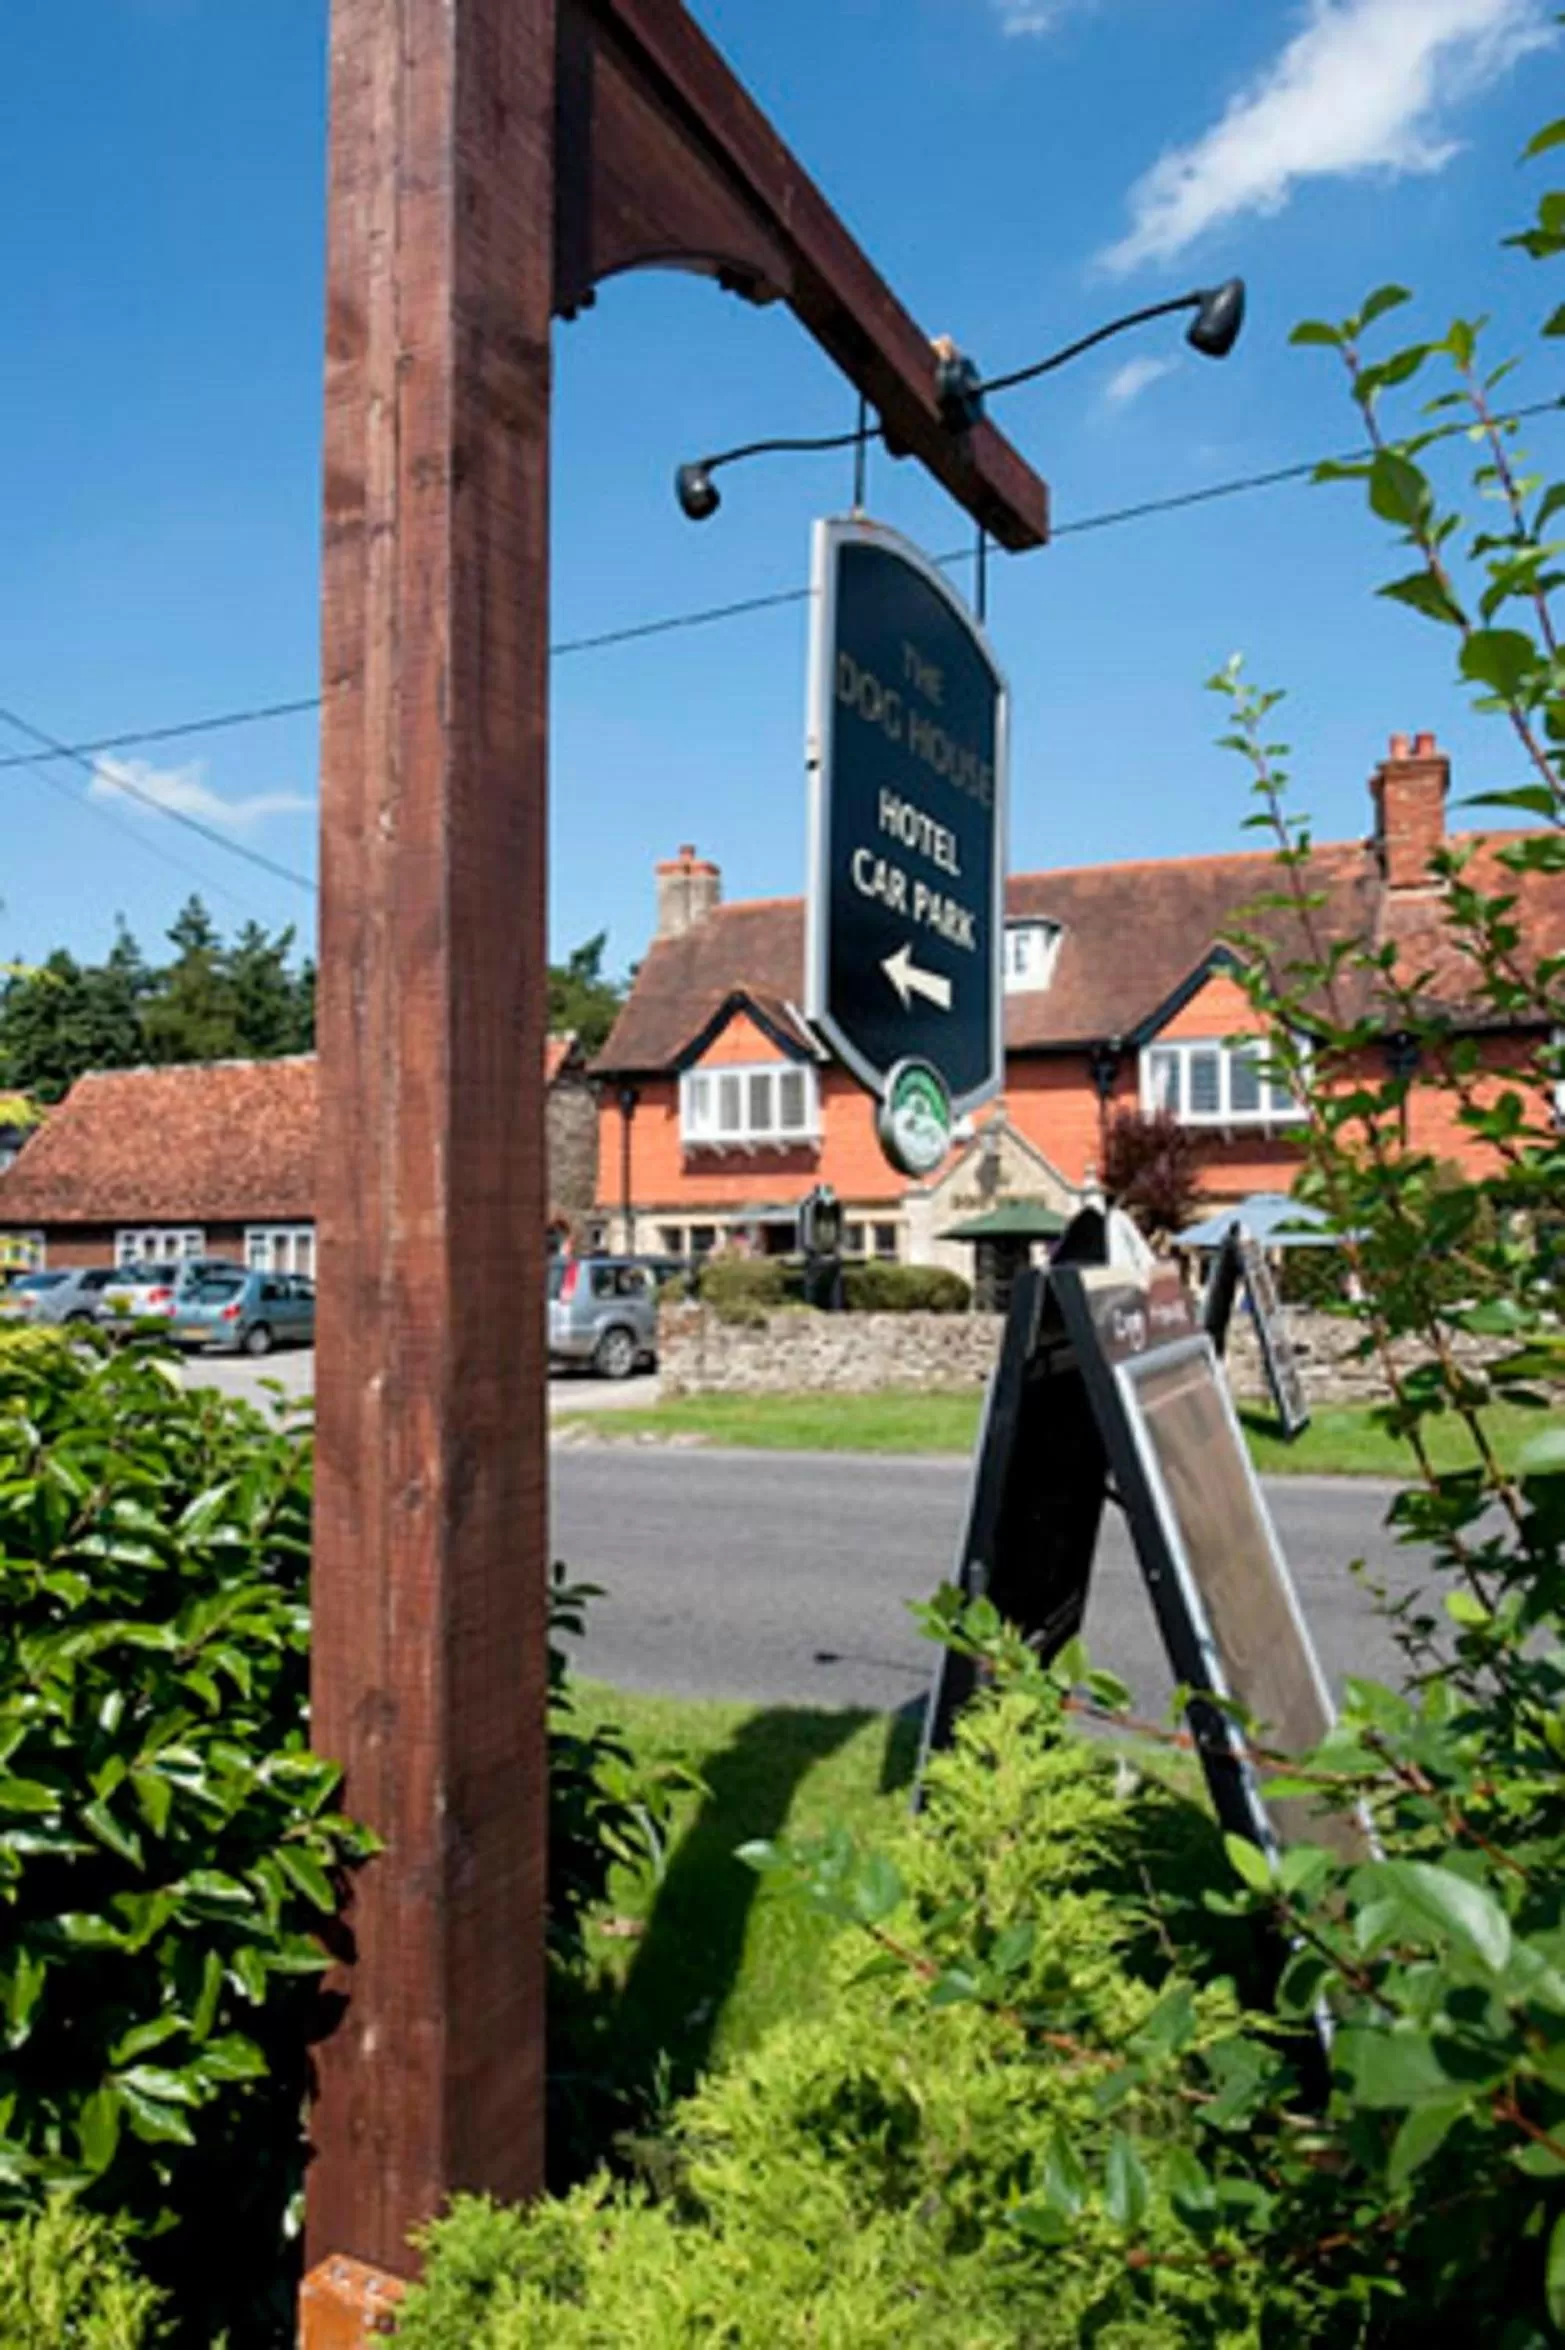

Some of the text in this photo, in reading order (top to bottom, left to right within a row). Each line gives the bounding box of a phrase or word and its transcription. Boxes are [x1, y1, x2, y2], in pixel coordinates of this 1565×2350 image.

[904, 641, 945, 707] THE
[837, 651, 994, 810] DOG HOUSE
[878, 784, 962, 877] HOTEL
[852, 846, 976, 953] CAR PARK
